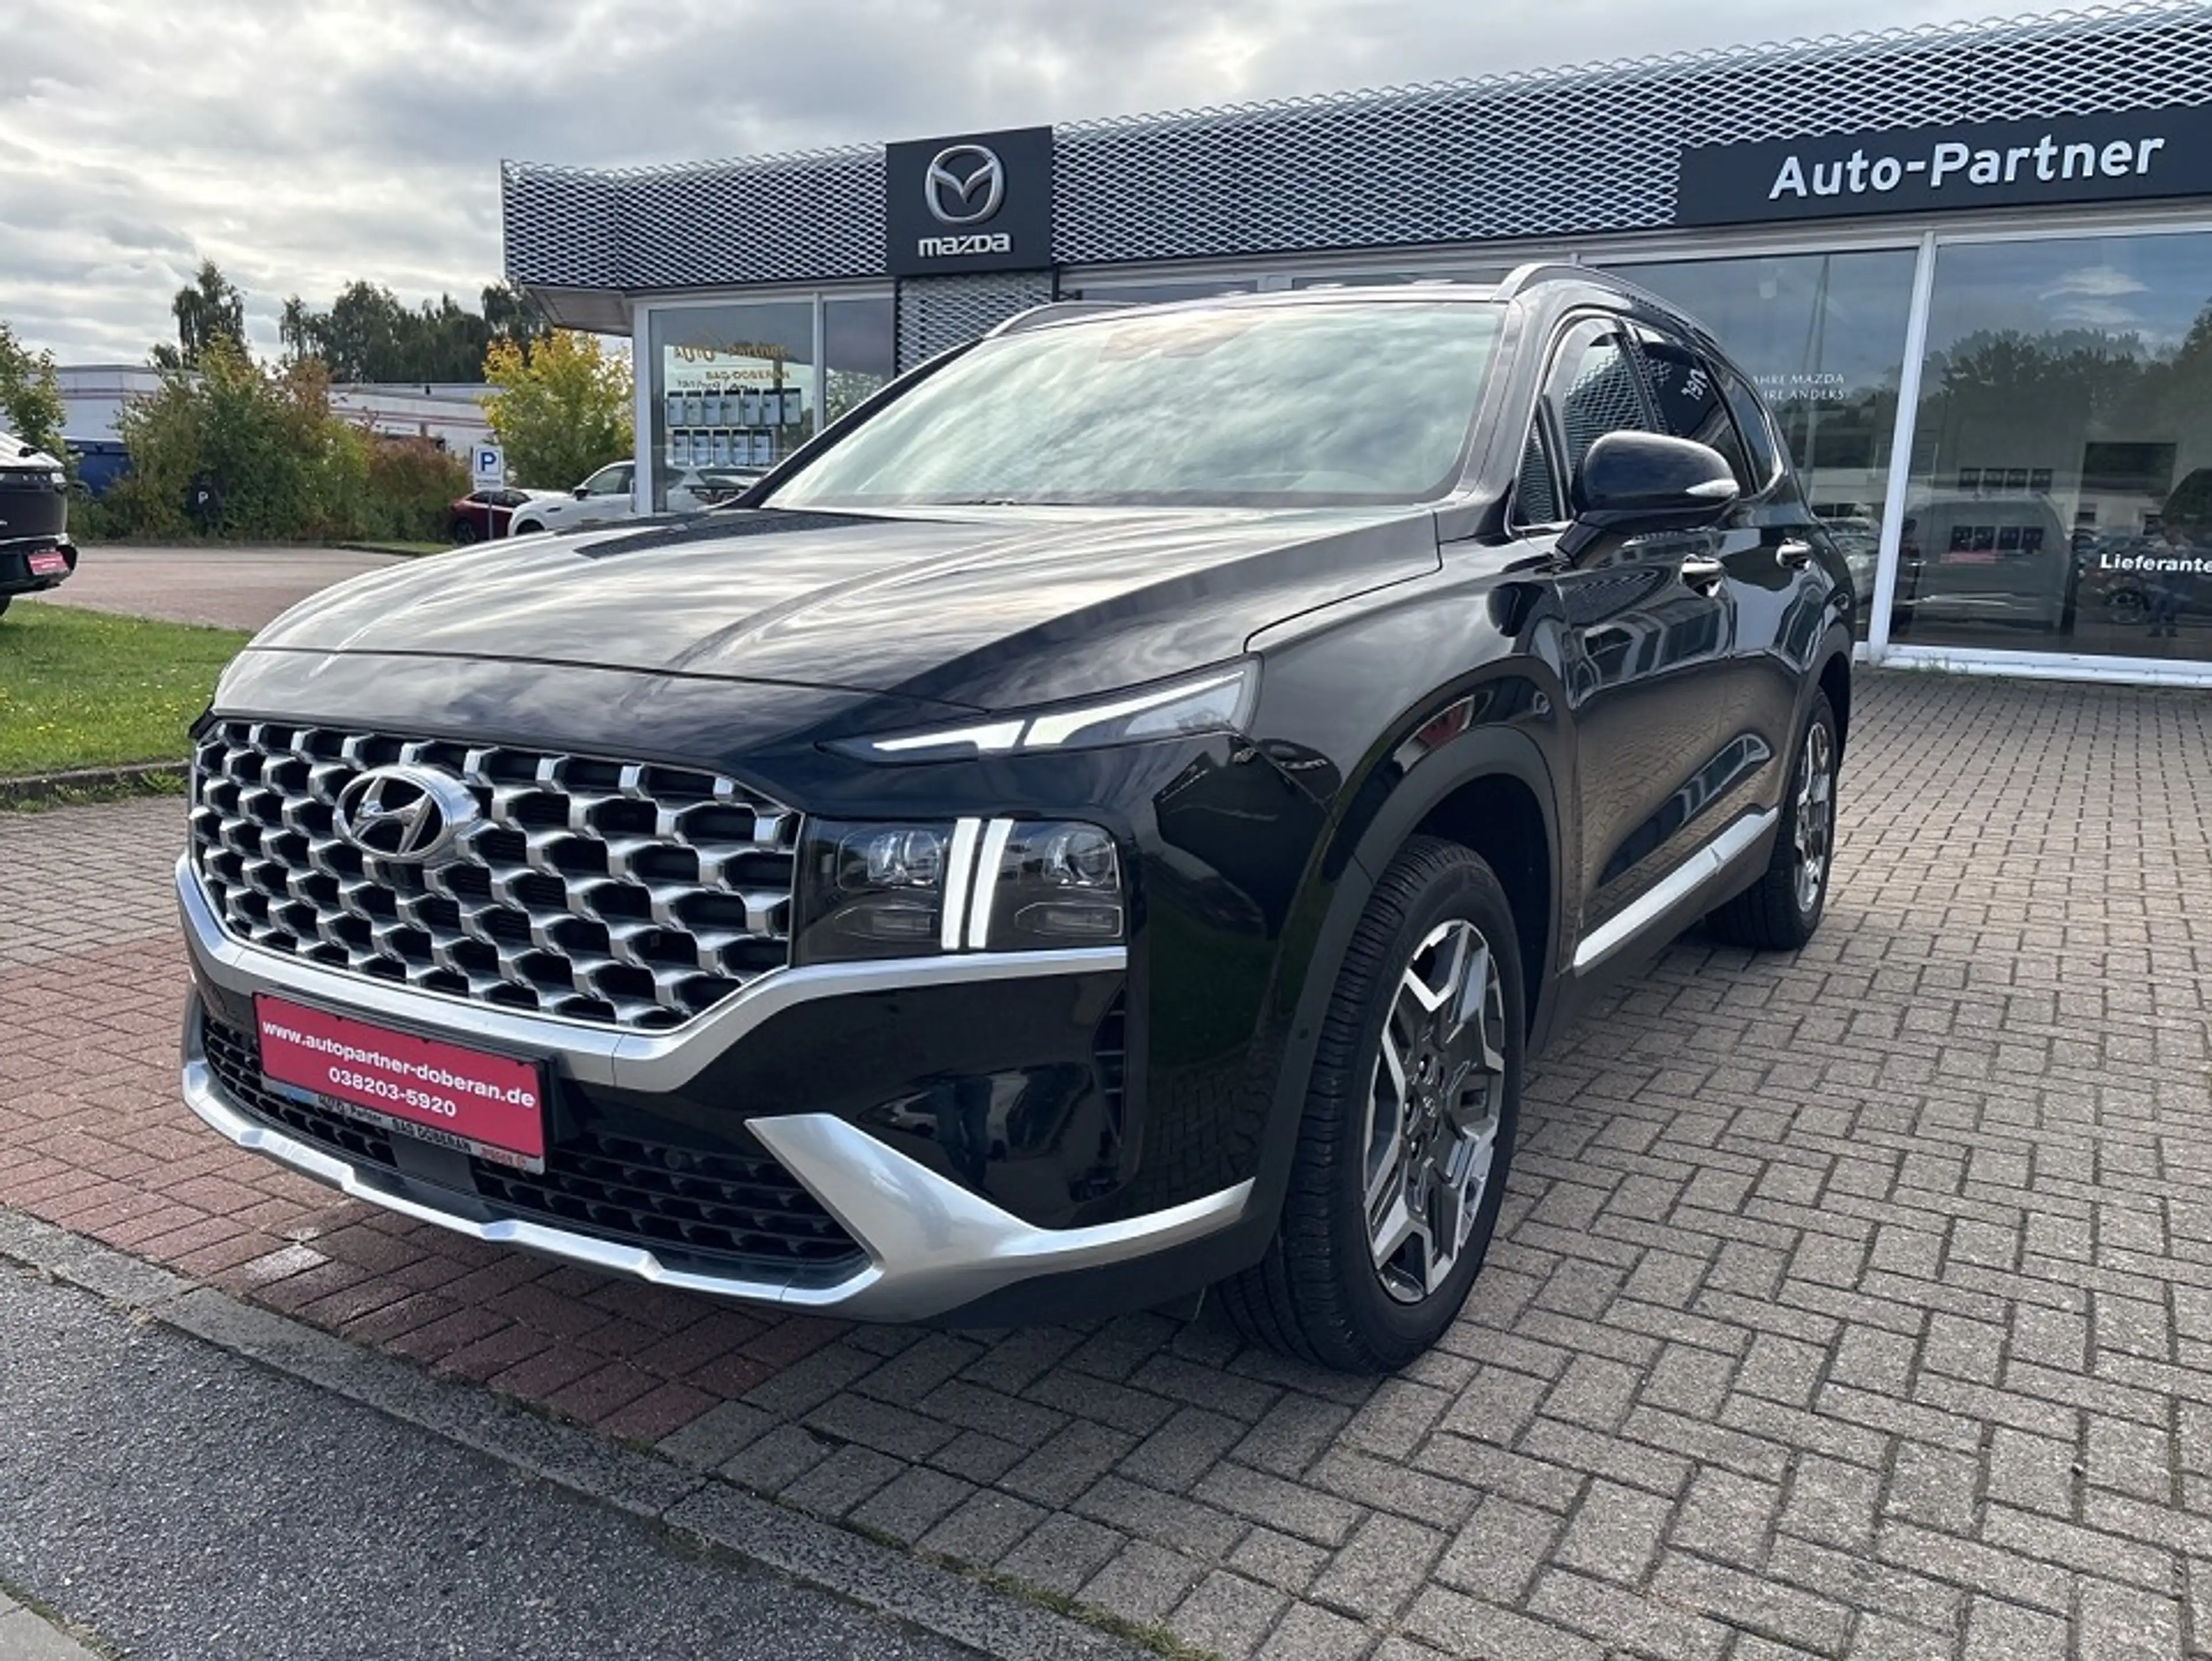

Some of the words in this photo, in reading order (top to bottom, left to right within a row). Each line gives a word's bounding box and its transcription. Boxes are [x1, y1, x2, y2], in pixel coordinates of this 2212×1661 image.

[1768, 133, 2166, 200] Auto-Partner
[918, 232, 1010, 257] mazda
[1790, 373, 1845, 385] MAZDA
[1789, 389, 1845, 400] ANDERS
[481, 452, 497, 471] P
[262, 1021, 536, 1108] www.autopartner-doberan.de
[328, 1066, 457, 1118] 038203-5920
